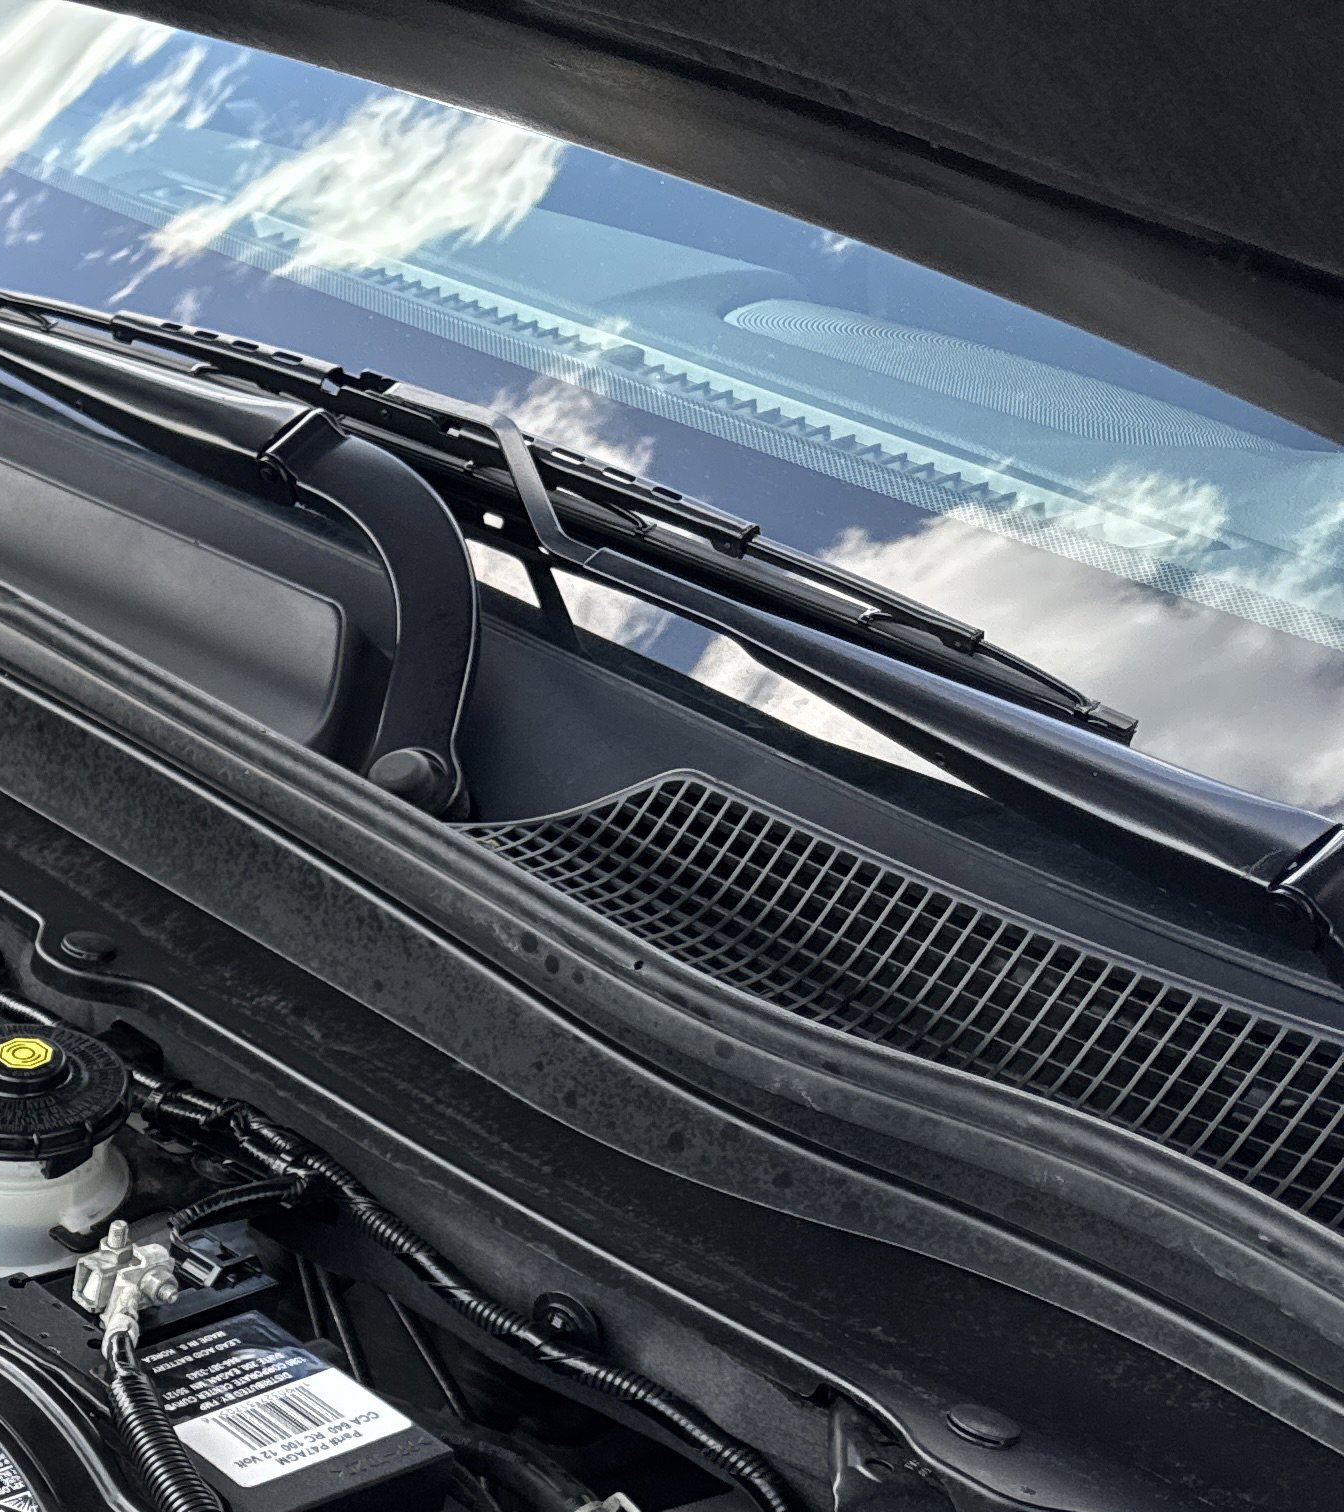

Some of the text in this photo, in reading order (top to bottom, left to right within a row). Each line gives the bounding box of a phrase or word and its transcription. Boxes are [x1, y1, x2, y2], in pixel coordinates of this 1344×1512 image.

[185, 1339, 200, 1347] IN
[196, 1329, 227, 1344] MADE
[139, 1347, 177, 1364] KOREA
[148, 1337, 242, 1374] LEAD ACID BATTERY
[229, 1361, 289, 1387] CORPORATE
[188, 1380, 208, 1390] MN
[193, 1381, 235, 1400] CENTER
[230, 1370, 293, 1397] DISTRIBUTED
[347, 1410, 381, 1426] CCA
[278, 1438, 305, 1452] 100
[302, 1431, 326, 1443] RC
[326, 1429, 363, 1446] Part#
[232, 1454, 263, 1469] Volt
[258, 1448, 279, 1459] 12
[274, 1441, 330, 1466] P47AGM
